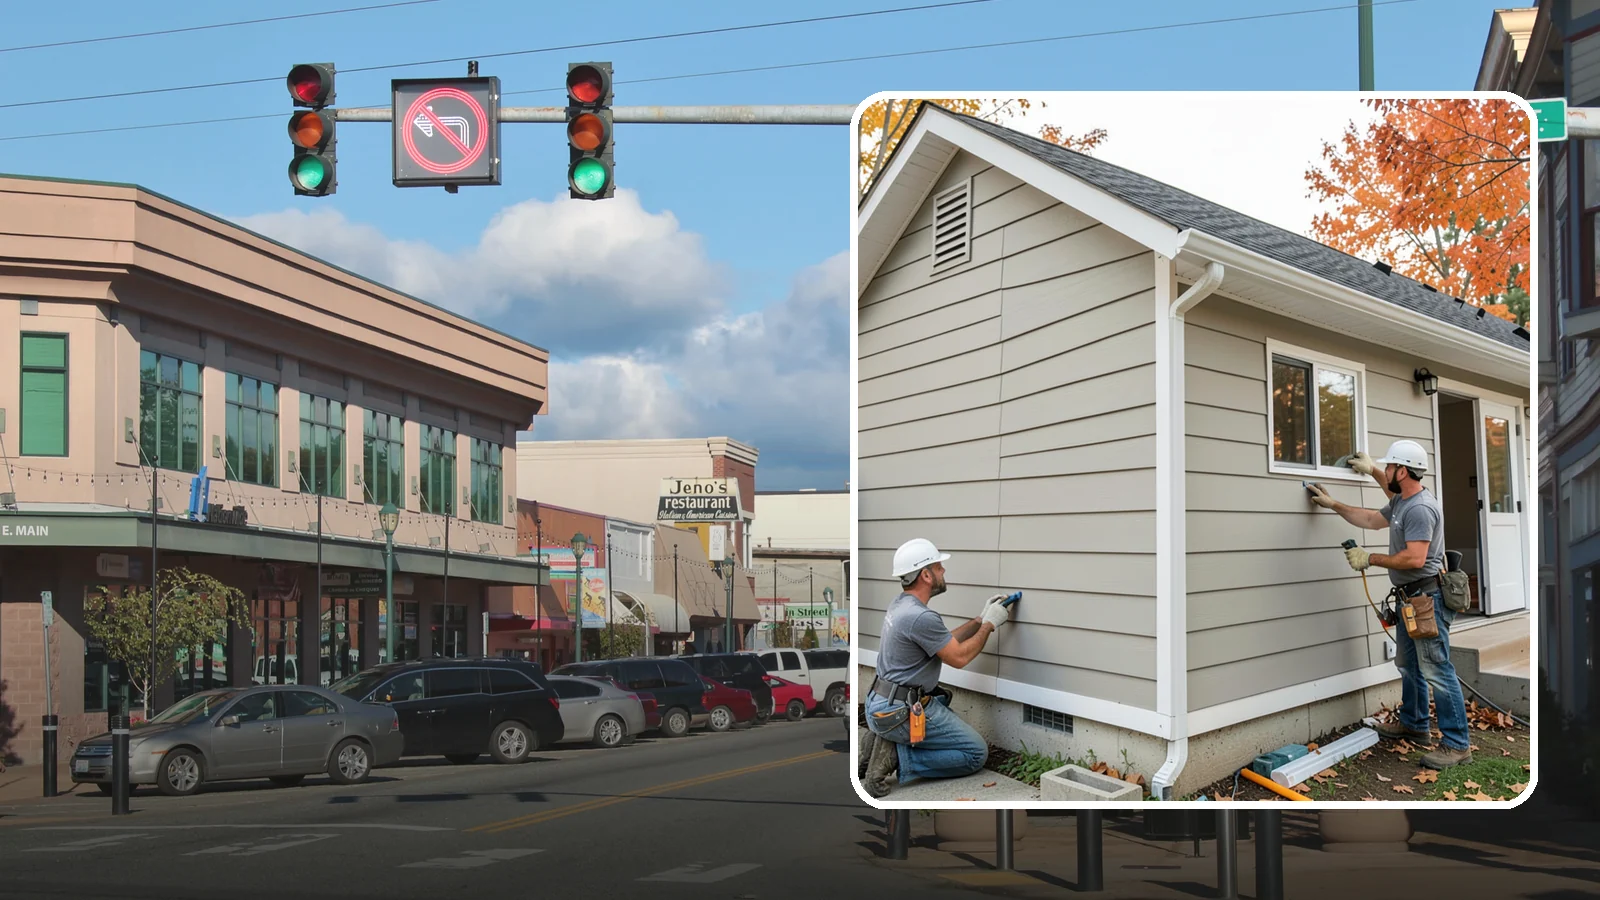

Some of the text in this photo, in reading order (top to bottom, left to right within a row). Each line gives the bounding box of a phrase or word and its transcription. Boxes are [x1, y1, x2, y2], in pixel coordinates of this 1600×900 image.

[670, 480, 727, 494] Jeno's
[665, 496, 731, 509] restaurant
[658, 509, 681, 519] Italian
[686, 509, 714, 519] American
[715, 509, 737, 519] Cuisine
[2, 525, 49, 536] E. MAIN
[797, 607, 828, 617] Street
[791, 619, 823, 627] lass
